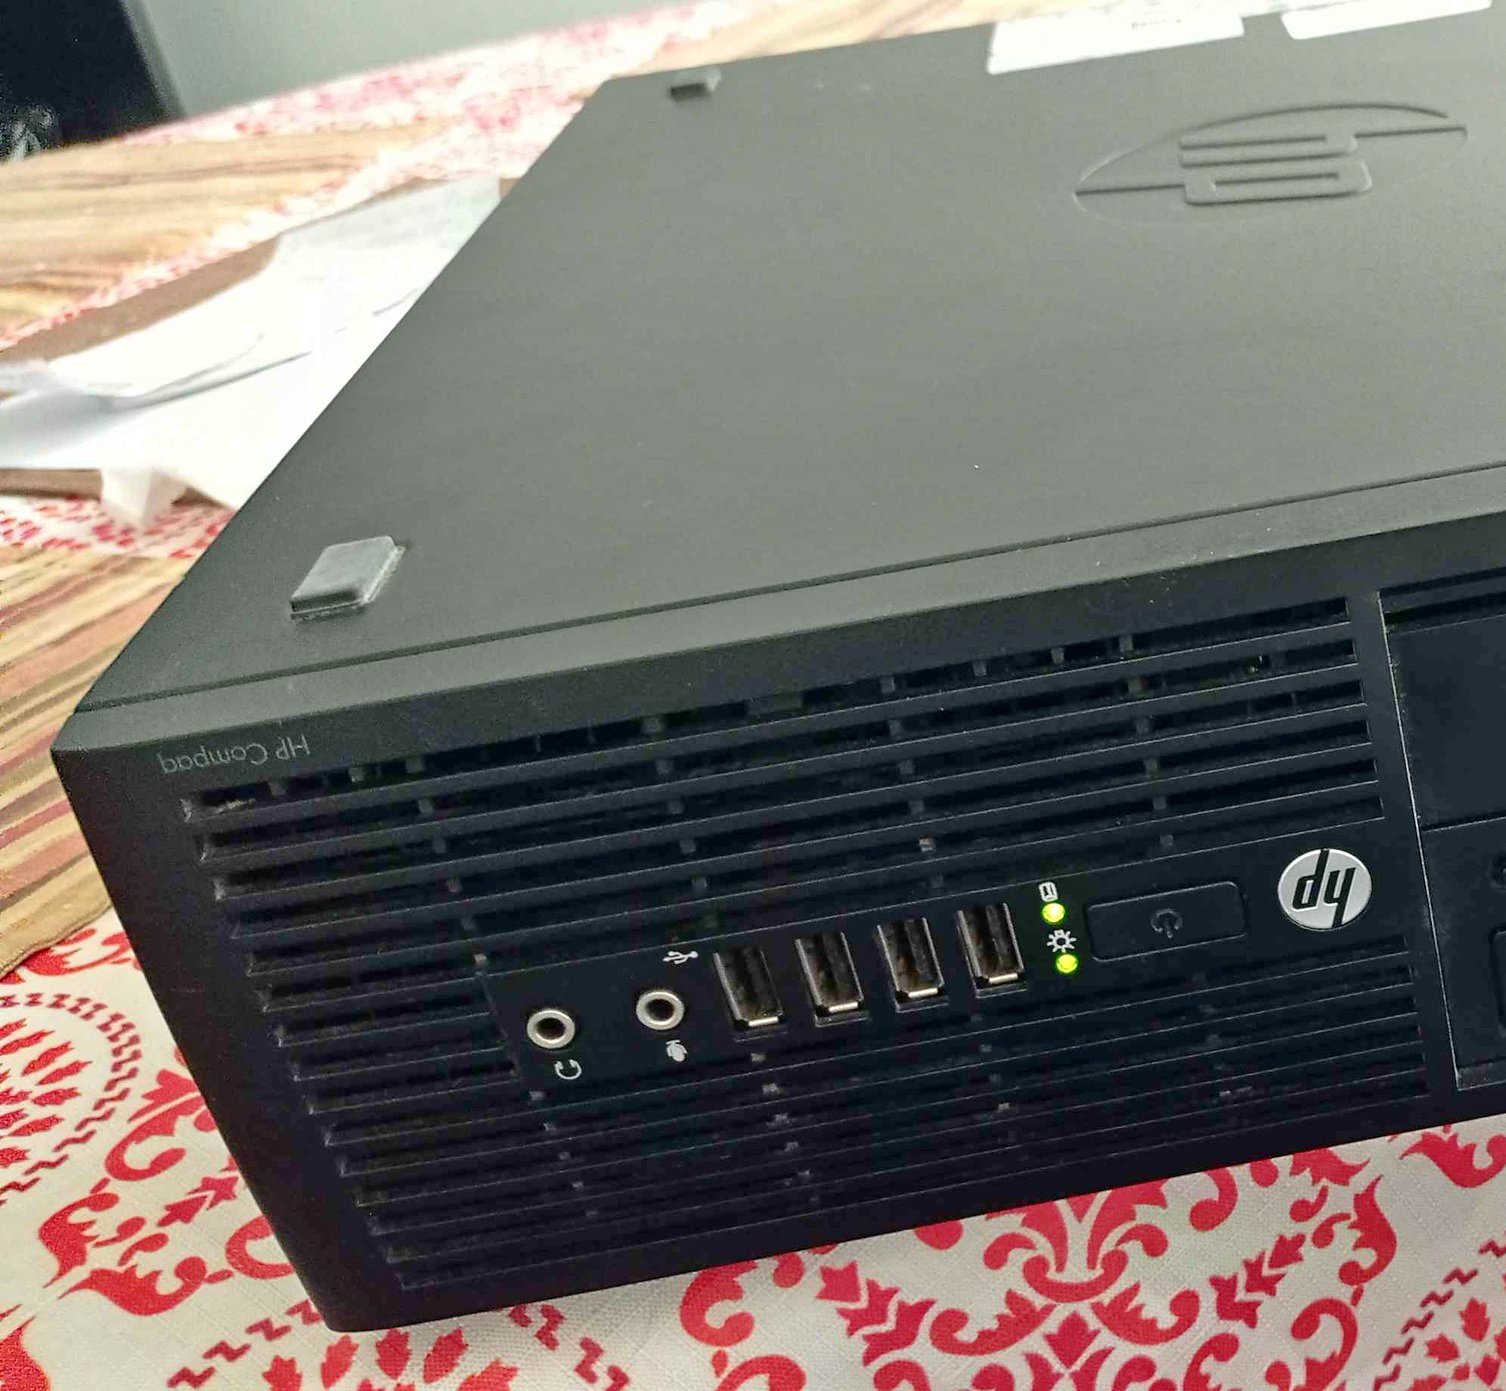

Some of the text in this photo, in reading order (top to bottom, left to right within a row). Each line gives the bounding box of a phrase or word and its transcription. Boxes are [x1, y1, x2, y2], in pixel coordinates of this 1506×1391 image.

[157, 733, 311, 774] HP Compaq
[1290, 847, 1358, 929] hp
